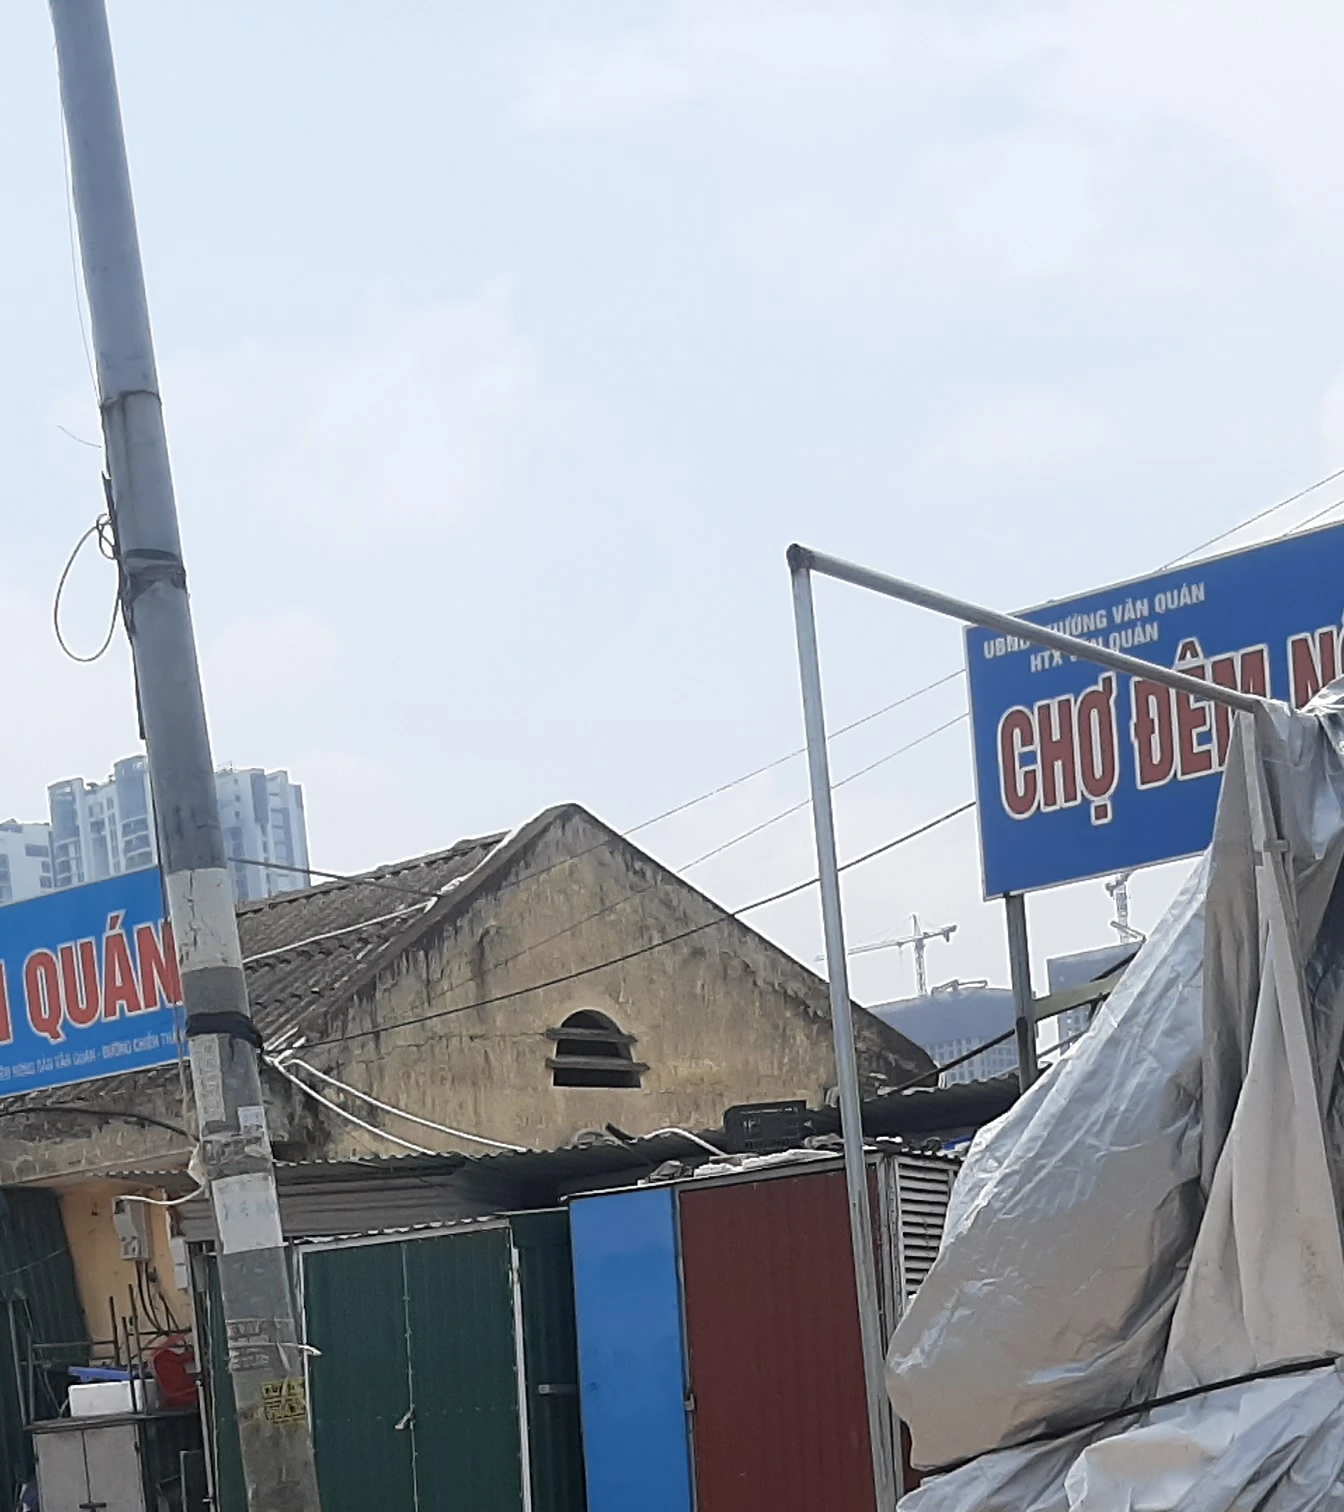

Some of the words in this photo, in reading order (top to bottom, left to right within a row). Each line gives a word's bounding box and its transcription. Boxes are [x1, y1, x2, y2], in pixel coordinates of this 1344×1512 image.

[1030, 648, 1064, 673] HTX
[1108, 621, 1160, 653] QUÁN
[1043, 610, 1107, 637] ƯỜNG
[1112, 598, 1150, 625] VĂN
[1154, 582, 1206, 614] QUÁN
[997, 671, 1118, 826] CHỢ
[1130, 637, 1270, 790] ĐÊM
[22, 910, 183, 1046] QUÁN
